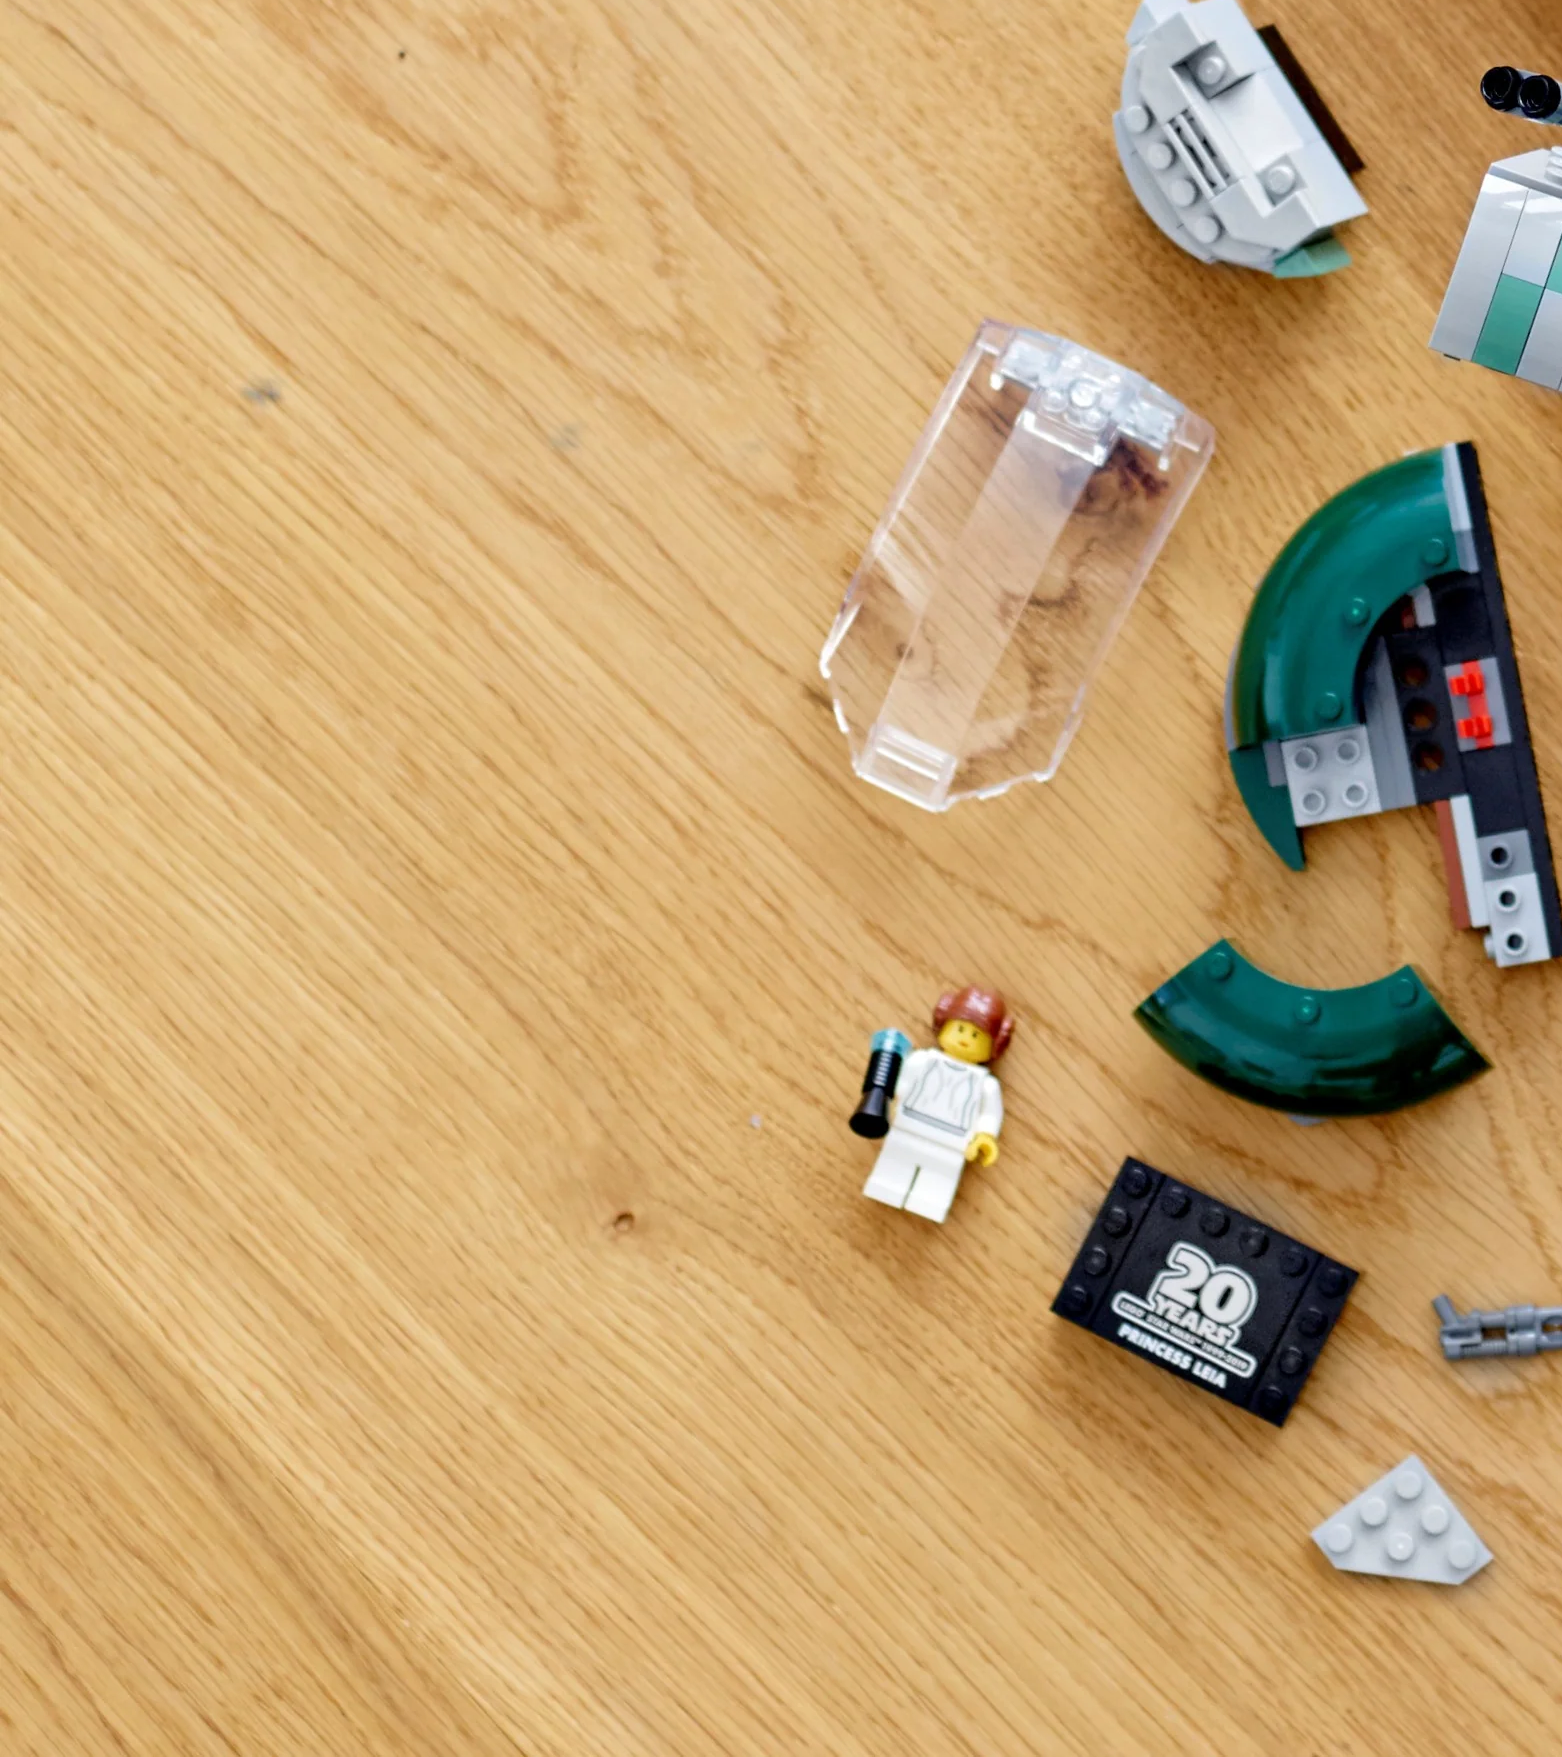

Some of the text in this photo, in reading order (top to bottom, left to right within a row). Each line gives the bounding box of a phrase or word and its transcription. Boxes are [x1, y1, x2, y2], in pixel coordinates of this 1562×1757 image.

[1158, 1249, 1251, 1324] 20
[1154, 1295, 1233, 1346] YEARS
[1118, 1323, 1227, 1388] PRINCESS LEIA
